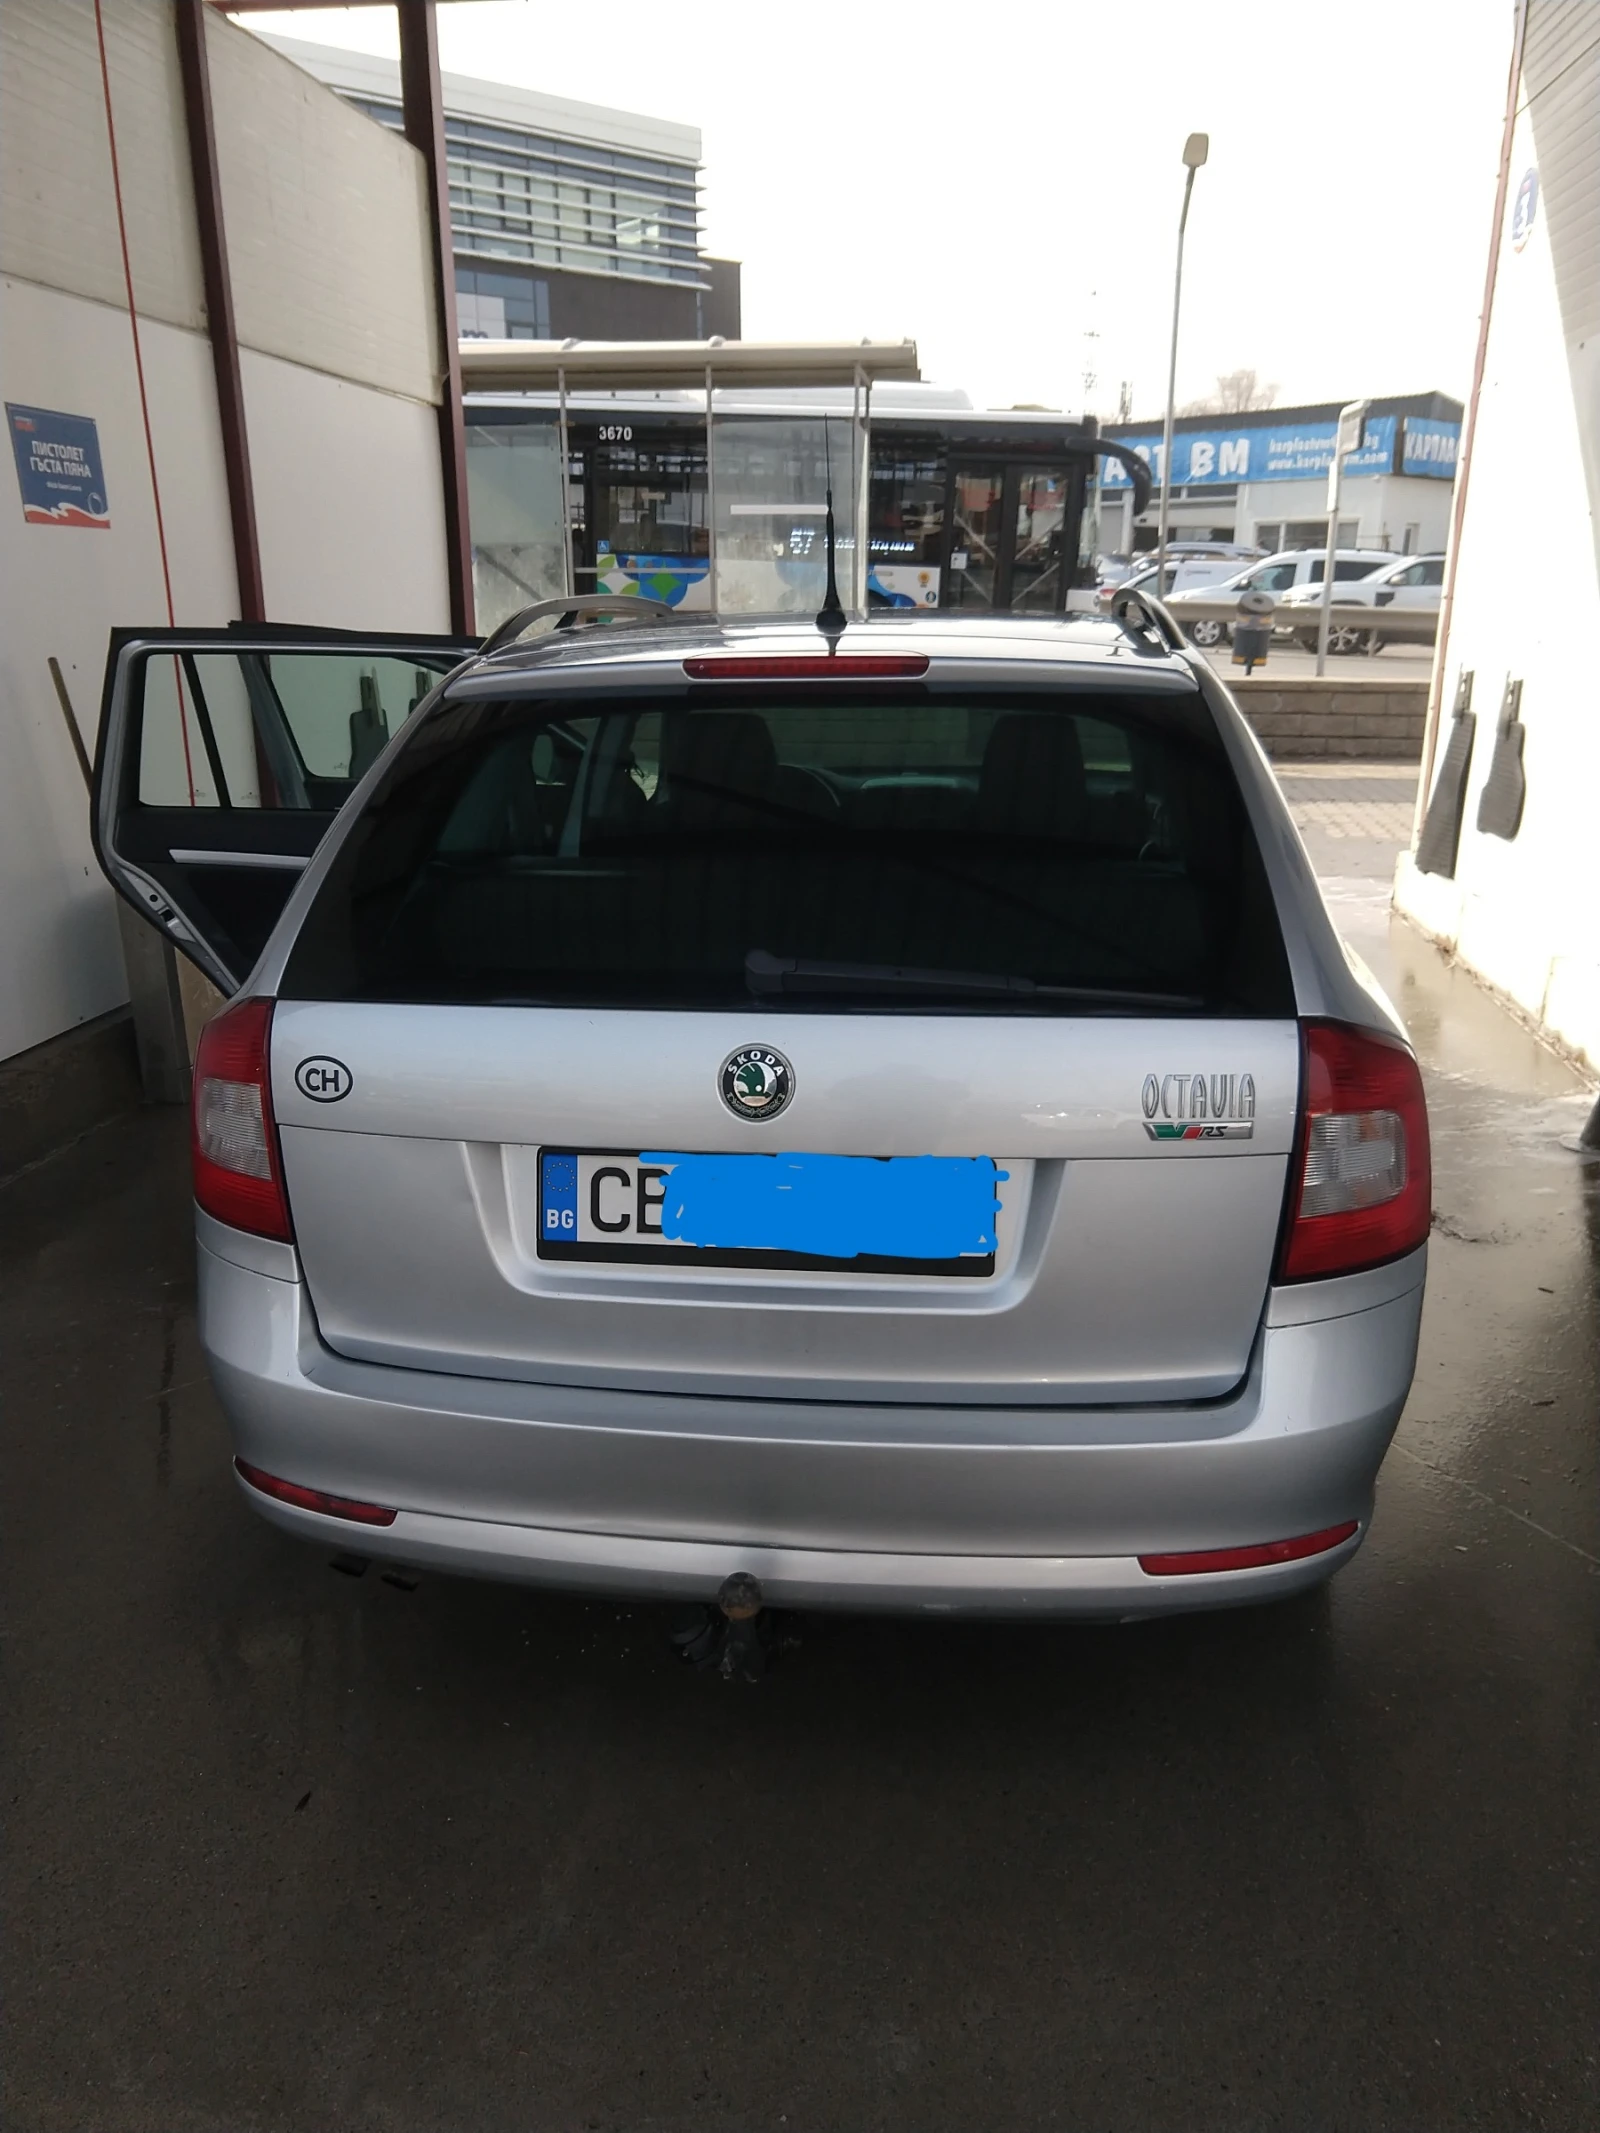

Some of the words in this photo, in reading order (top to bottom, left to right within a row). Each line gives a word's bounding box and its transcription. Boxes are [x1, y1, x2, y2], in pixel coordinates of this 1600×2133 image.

[599, 425, 633, 441] 3670
[31, 440, 84, 461] ПИСТОЛЕТ
[29, 457, 63, 474] ГЪСТА
[64, 461, 92, 478] ПЯНА
[727, 1050, 785, 1077] SKODA
[305, 1067, 340, 1092] CH
[1141, 1073, 1256, 1119] OCTAVIA
[546, 1208, 574, 1229] BG
